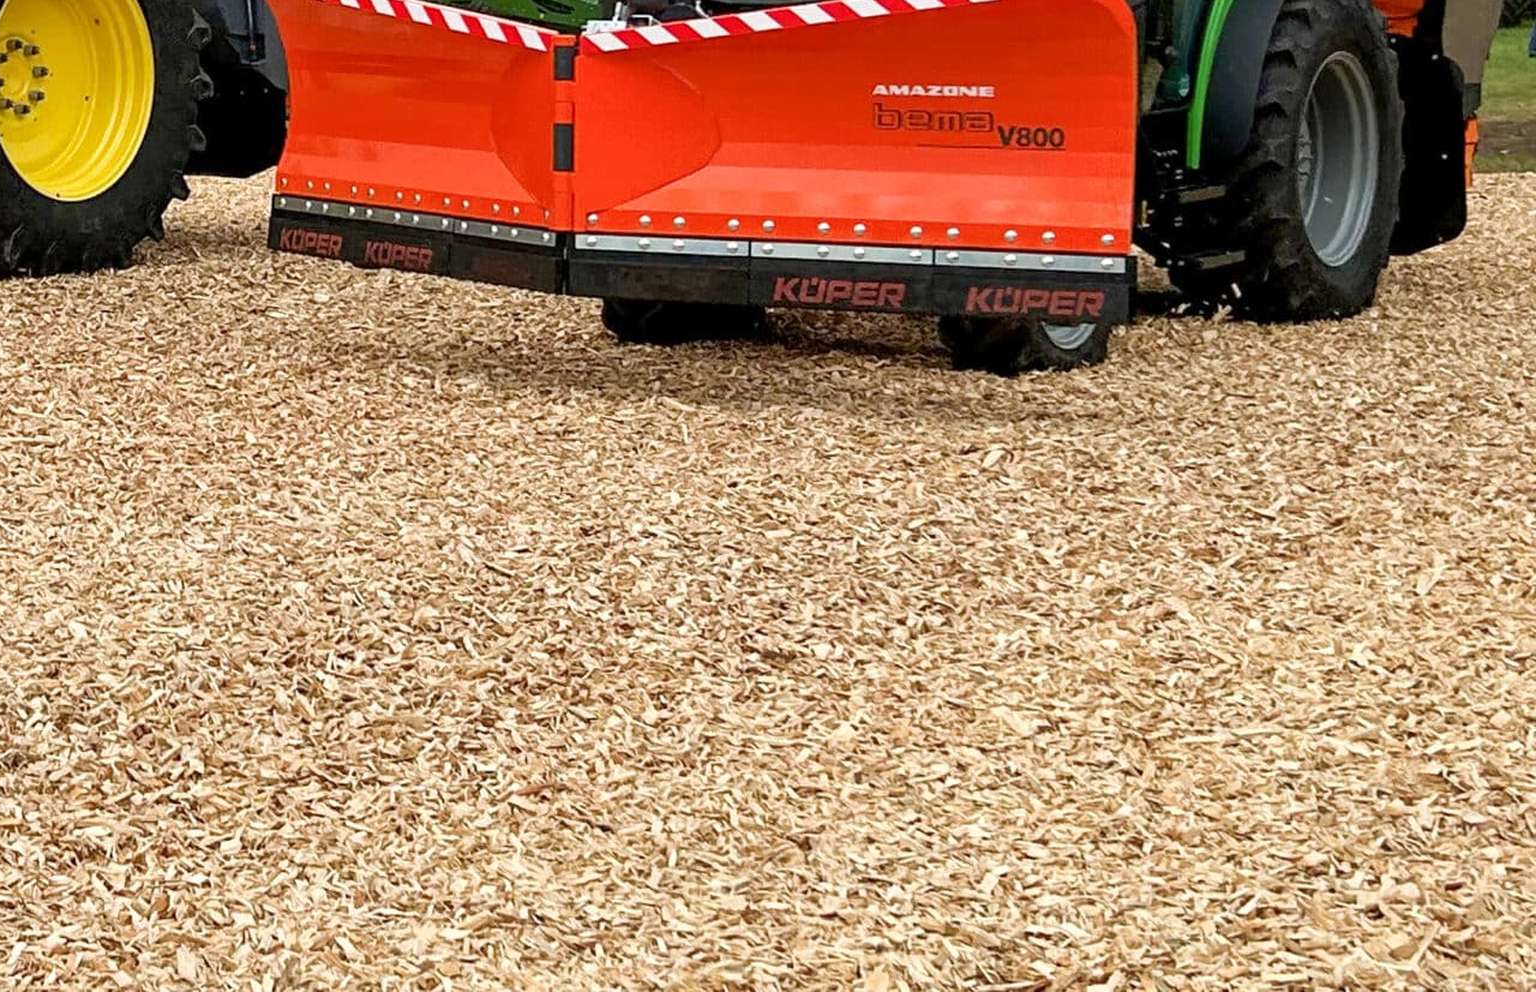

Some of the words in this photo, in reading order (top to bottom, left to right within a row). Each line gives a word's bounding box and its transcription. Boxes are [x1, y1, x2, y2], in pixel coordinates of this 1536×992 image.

[872, 84, 996, 98] AMAZONE
[872, 102, 995, 133] bema
[996, 125, 1064, 148] V800
[279, 226, 344, 257] KÜPER
[365, 239, 433, 271] KÜPER
[772, 276, 907, 308] KÜPER
[965, 286, 1106, 318] KÜPER
